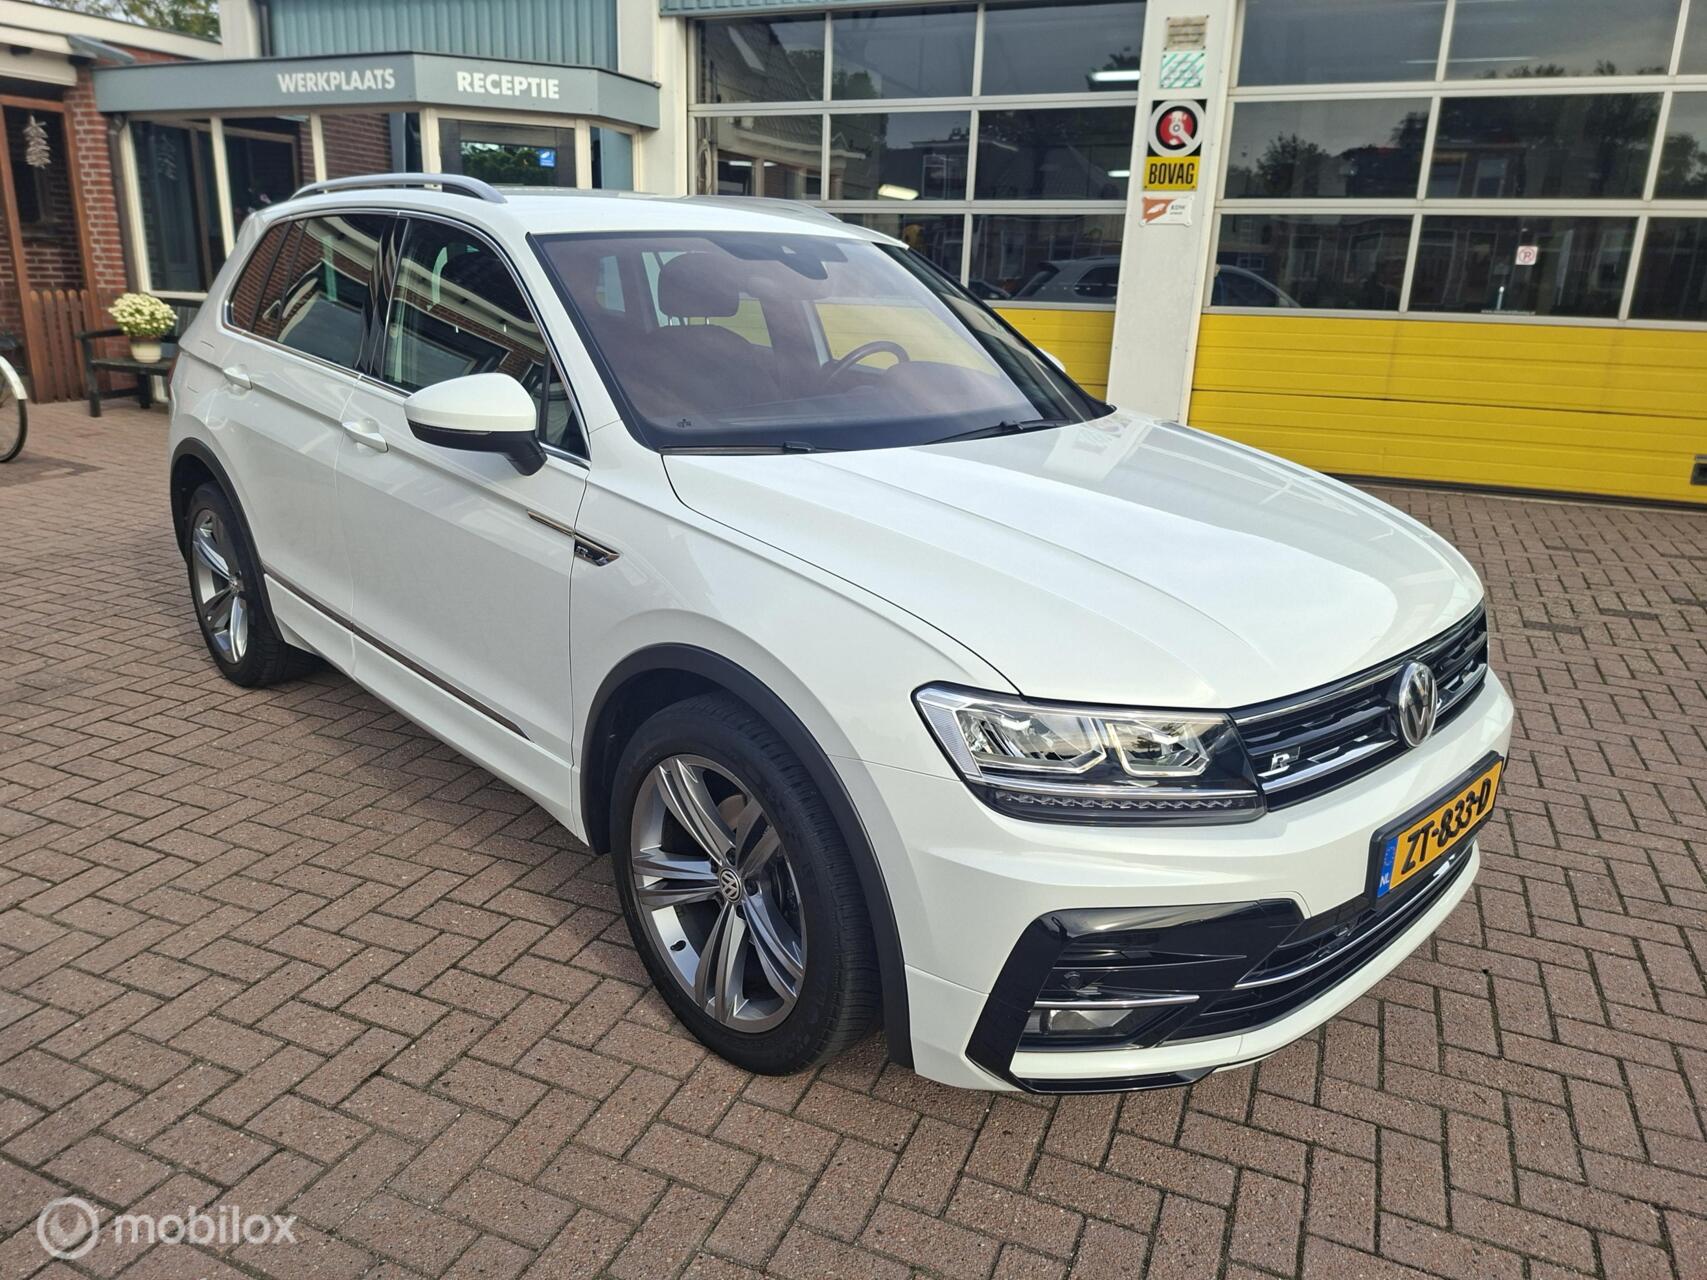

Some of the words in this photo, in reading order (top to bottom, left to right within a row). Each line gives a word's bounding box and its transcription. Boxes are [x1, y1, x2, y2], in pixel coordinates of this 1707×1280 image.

[277, 69, 396, 93] WERKPLAATS
[456, 71, 560, 99] RECEPTIE
[1148, 163, 1195, 185] BOVAG
[1401, 778, 1492, 875] ZT-833-D
[1379, 873, 1390, 888] NL
